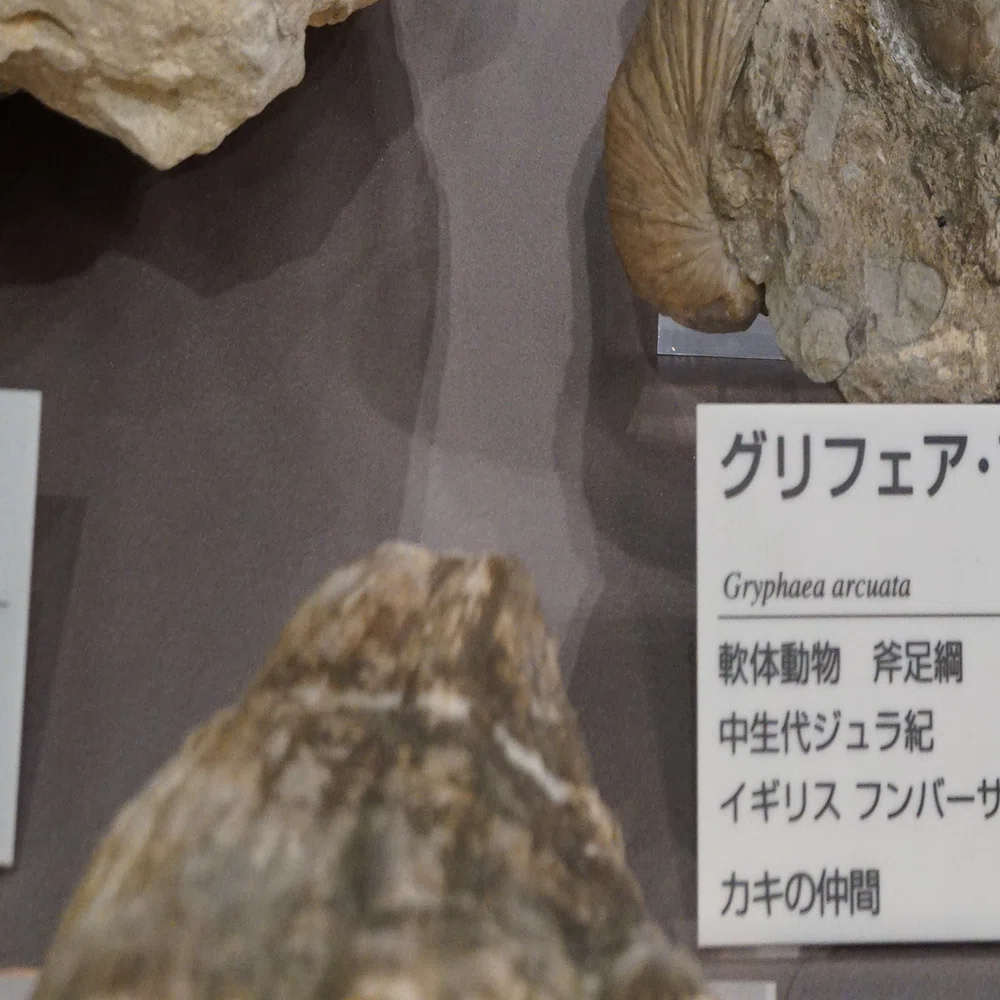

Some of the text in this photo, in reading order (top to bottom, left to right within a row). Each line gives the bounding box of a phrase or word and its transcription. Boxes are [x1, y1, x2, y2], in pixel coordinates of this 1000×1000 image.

[722, 571, 911, 607] Gryphaea arcuata
[718, 640, 964, 687] 軟体動物 斧足綱
[718, 709, 935, 756] 中生代ジュラ紀
[719, 779, 842, 824] イギリス
[720, 867, 881, 918] カキの仲間
